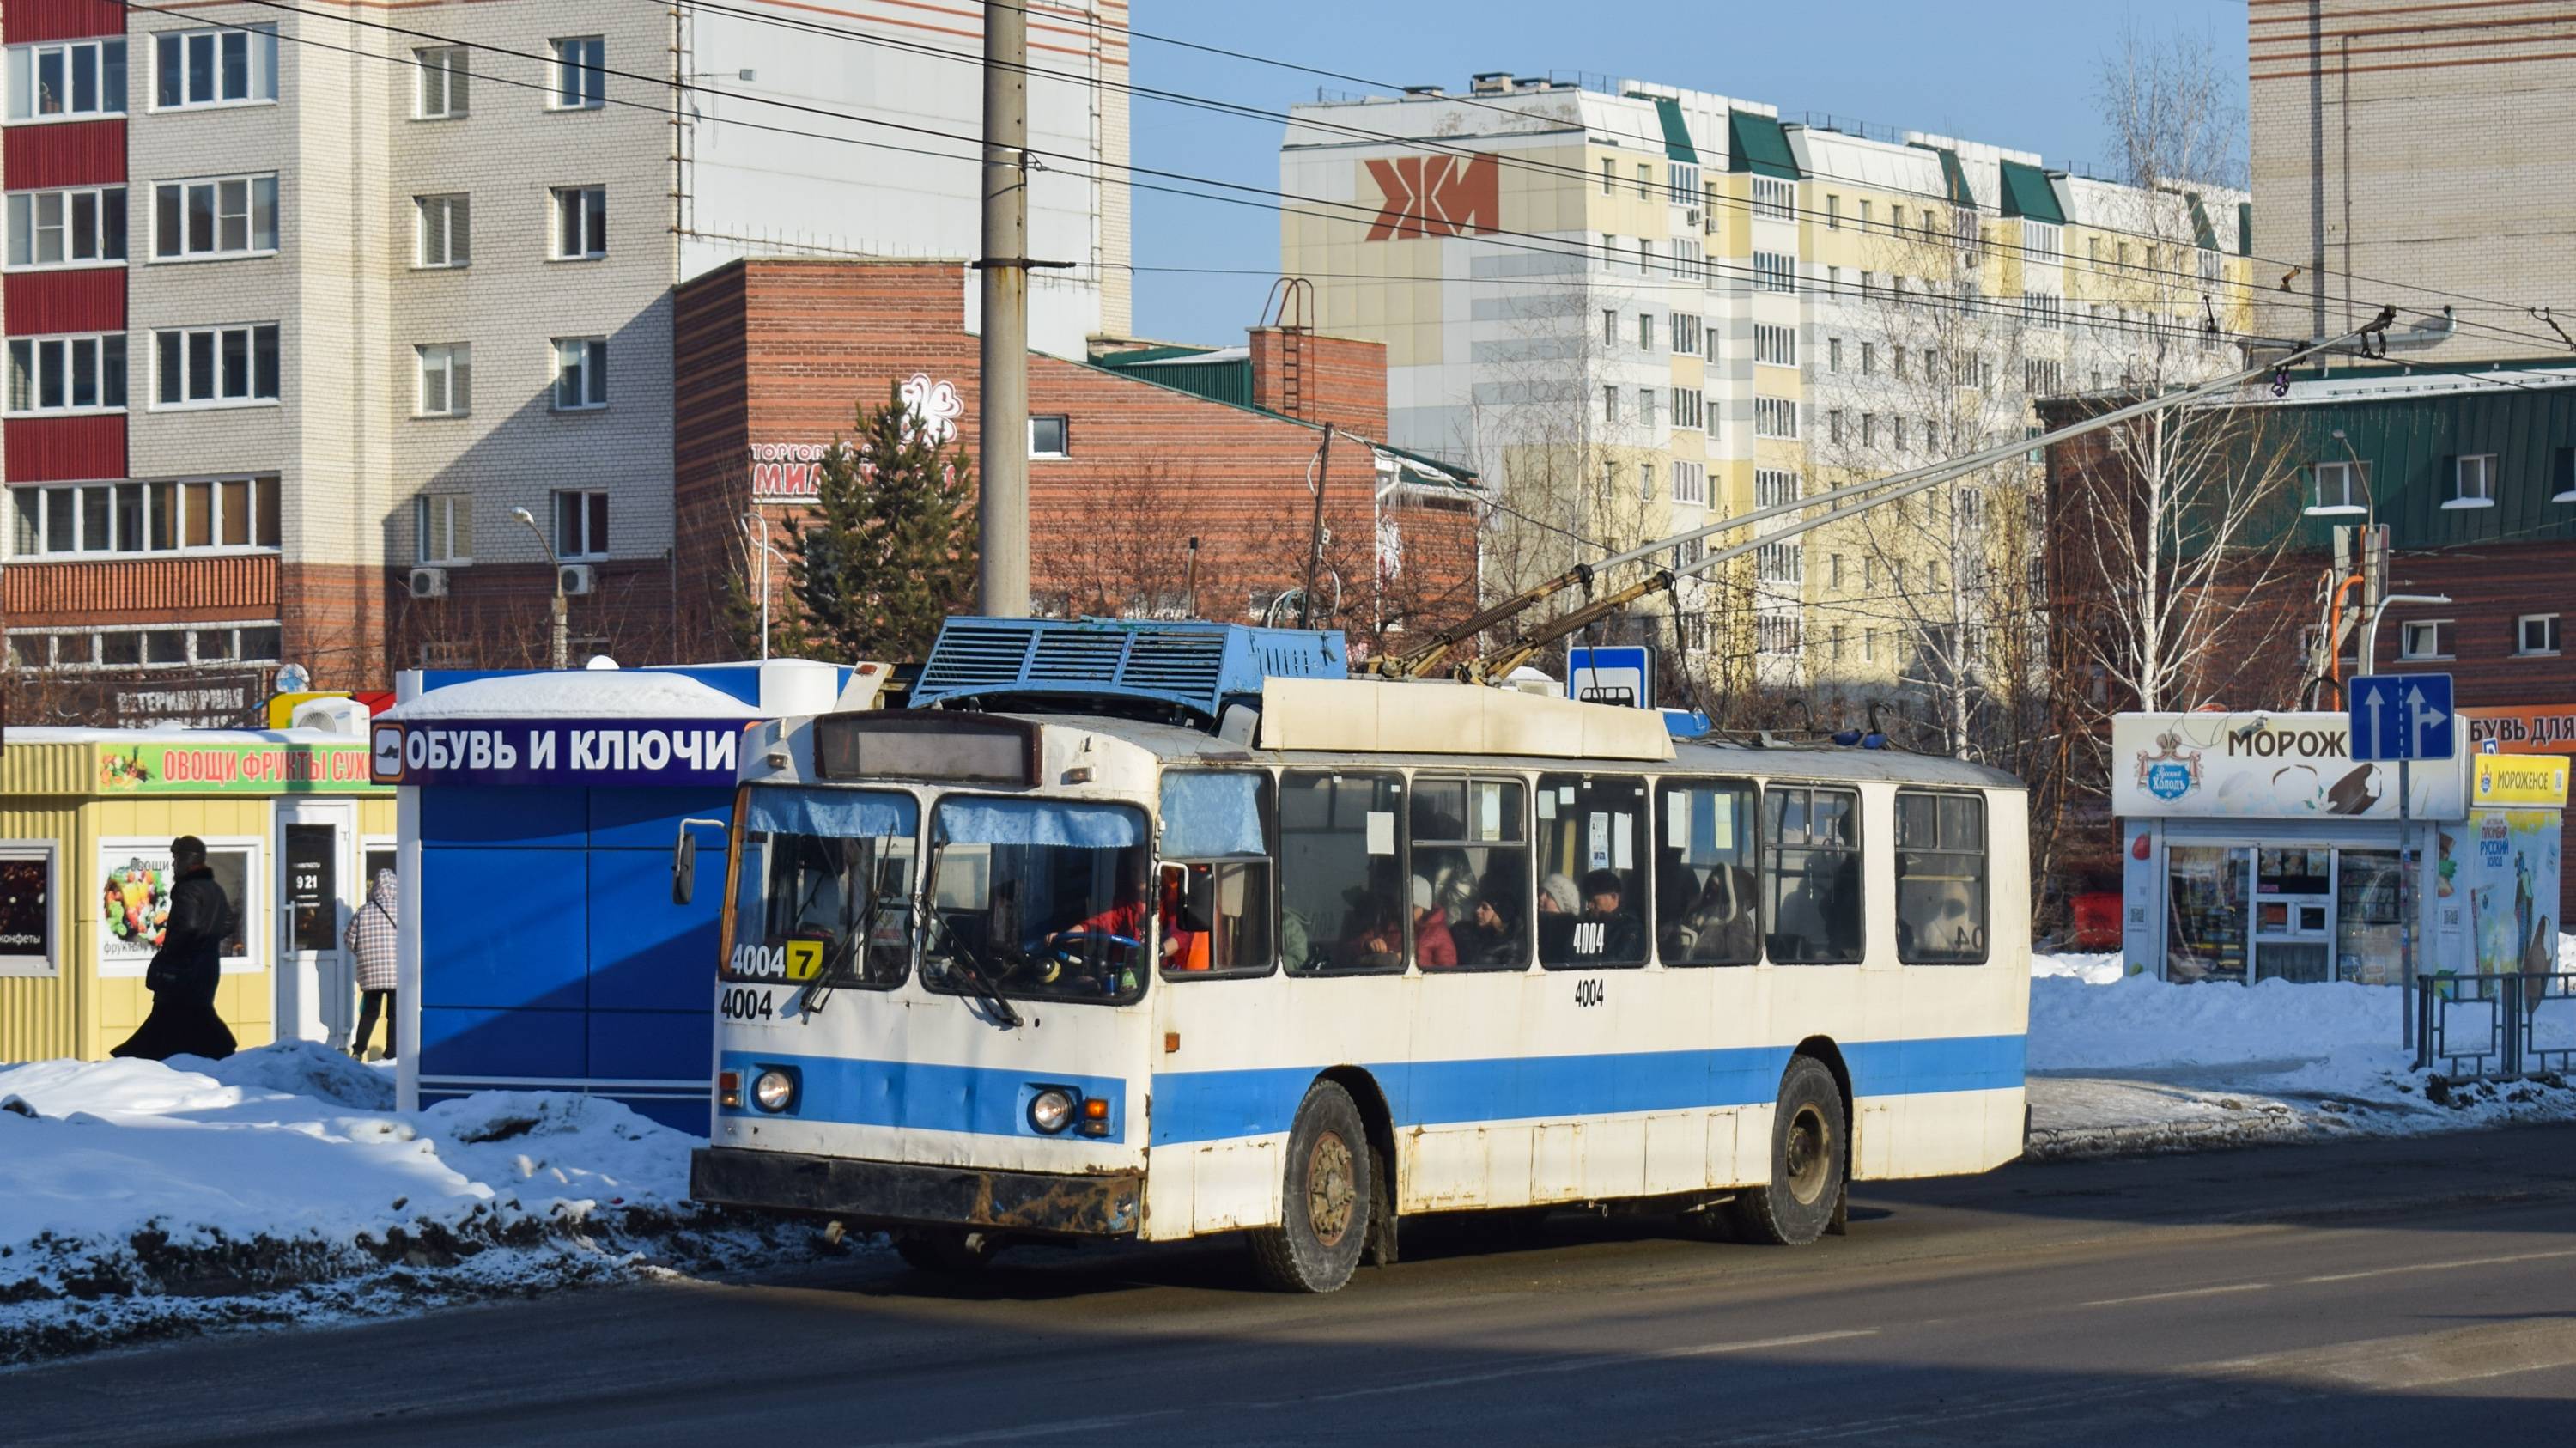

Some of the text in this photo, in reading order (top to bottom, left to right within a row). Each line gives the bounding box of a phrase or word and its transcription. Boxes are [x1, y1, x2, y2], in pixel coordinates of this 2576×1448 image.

[2228, 731, 2347, 757] МОРОЖ
[2530, 716, 2576, 745] ДЛЯ
[406, 730, 736, 770] ОБУВЬ И КЛЮЧИ
[164, 751, 237, 786] ОВОЩИ
[242, 751, 326, 782] ФРУКТЫ
[2497, 770, 2548, 789] МОРОЖЕНОЕ
[2480, 838, 2509, 855] РУССКИЙ
[1573, 923, 1604, 953] 4004
[731, 944, 785, 977] 4004
[795, 950, 813, 976] 7
[721, 989, 772, 1020] 4004
[1575, 979, 1603, 1007] 4004
